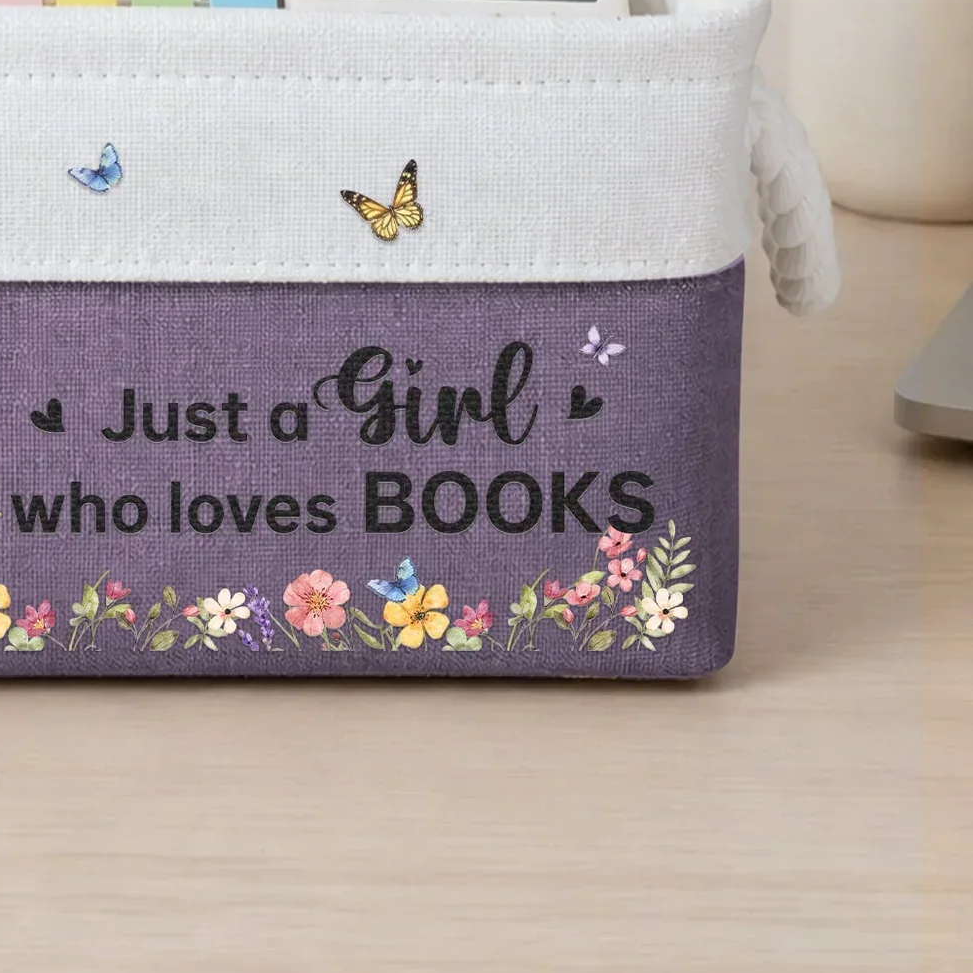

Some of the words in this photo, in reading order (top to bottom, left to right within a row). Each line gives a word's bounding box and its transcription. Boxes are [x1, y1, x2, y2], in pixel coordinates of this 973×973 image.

[100, 388, 248, 443] Just
[270, 398, 310, 443] a
[313, 340, 539, 447] Girl
[11, 480, 150, 534] who
[170, 481, 337, 534] loves
[364, 470, 657, 535] BOOKS
